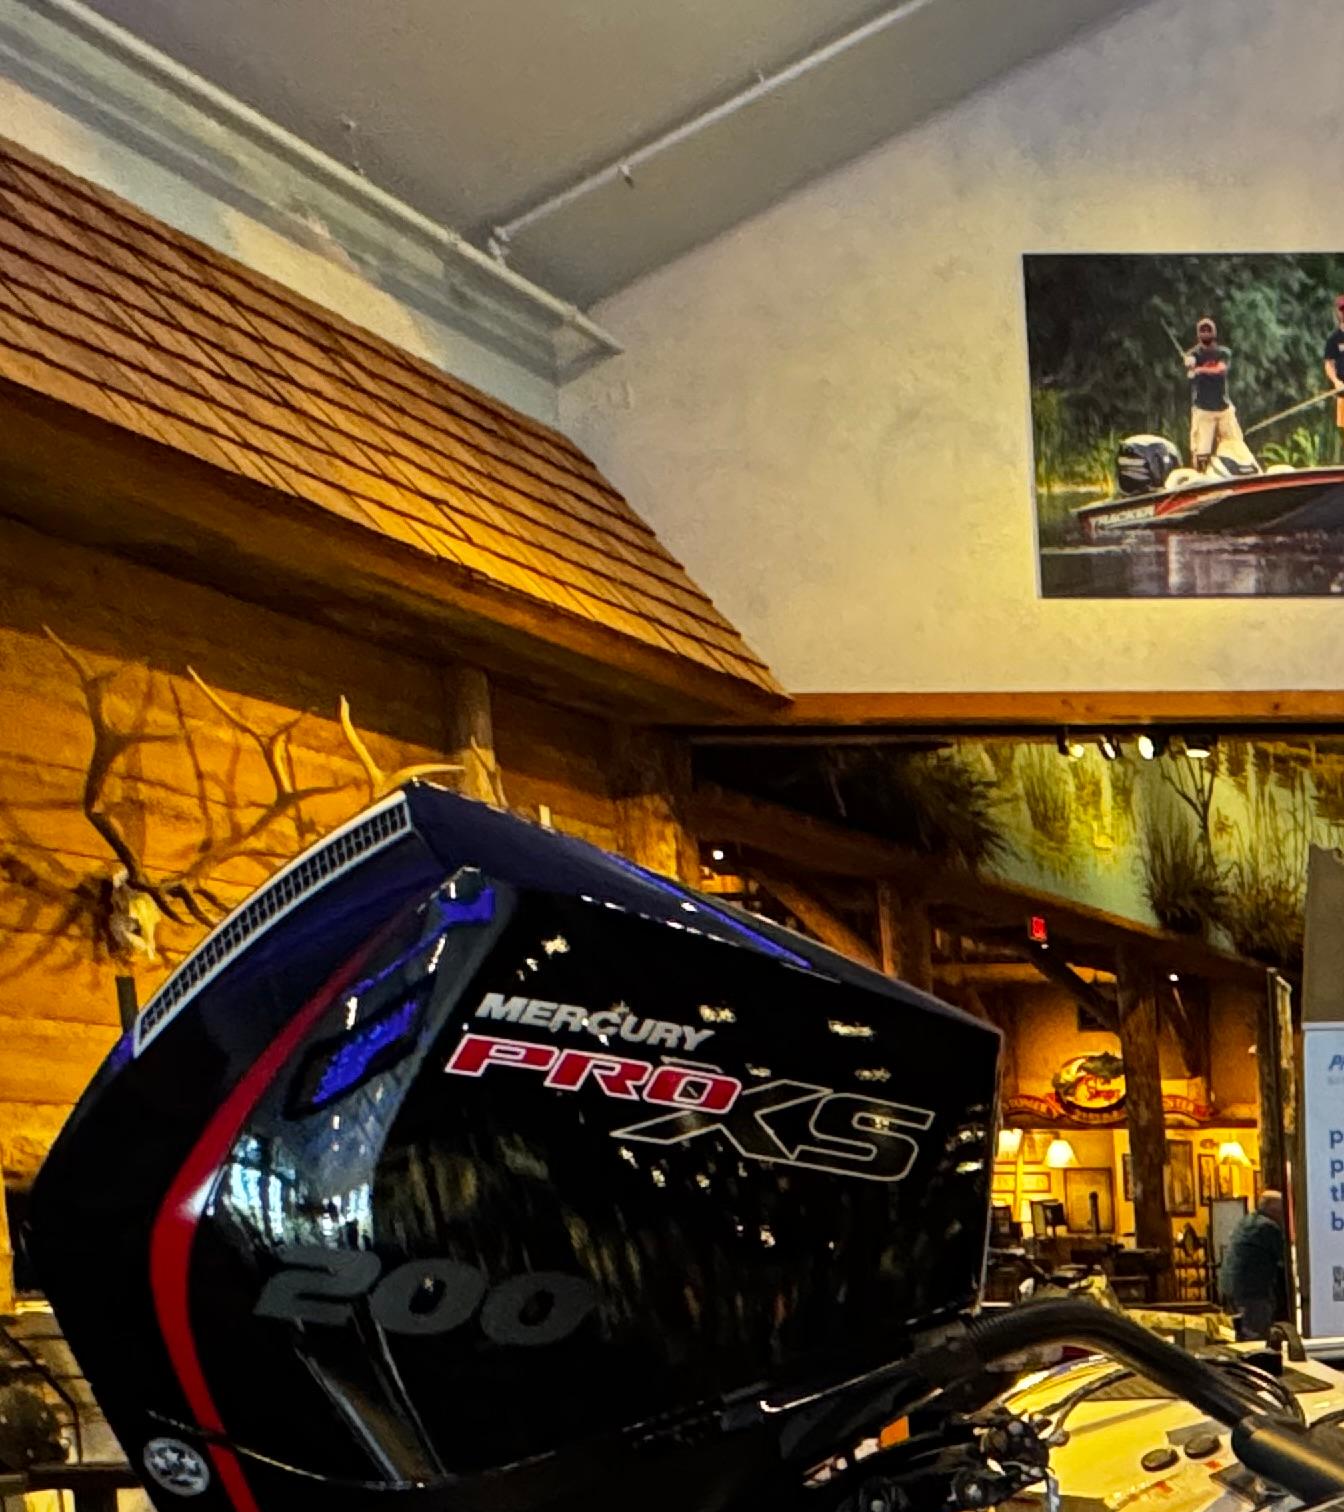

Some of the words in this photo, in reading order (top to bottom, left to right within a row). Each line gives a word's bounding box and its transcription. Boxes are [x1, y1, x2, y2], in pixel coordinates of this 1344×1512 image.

[475, 993, 714, 1051] MERCURY
[445, 1033, 741, 1114] PRO
[255, 1244, 597, 1346] 200
